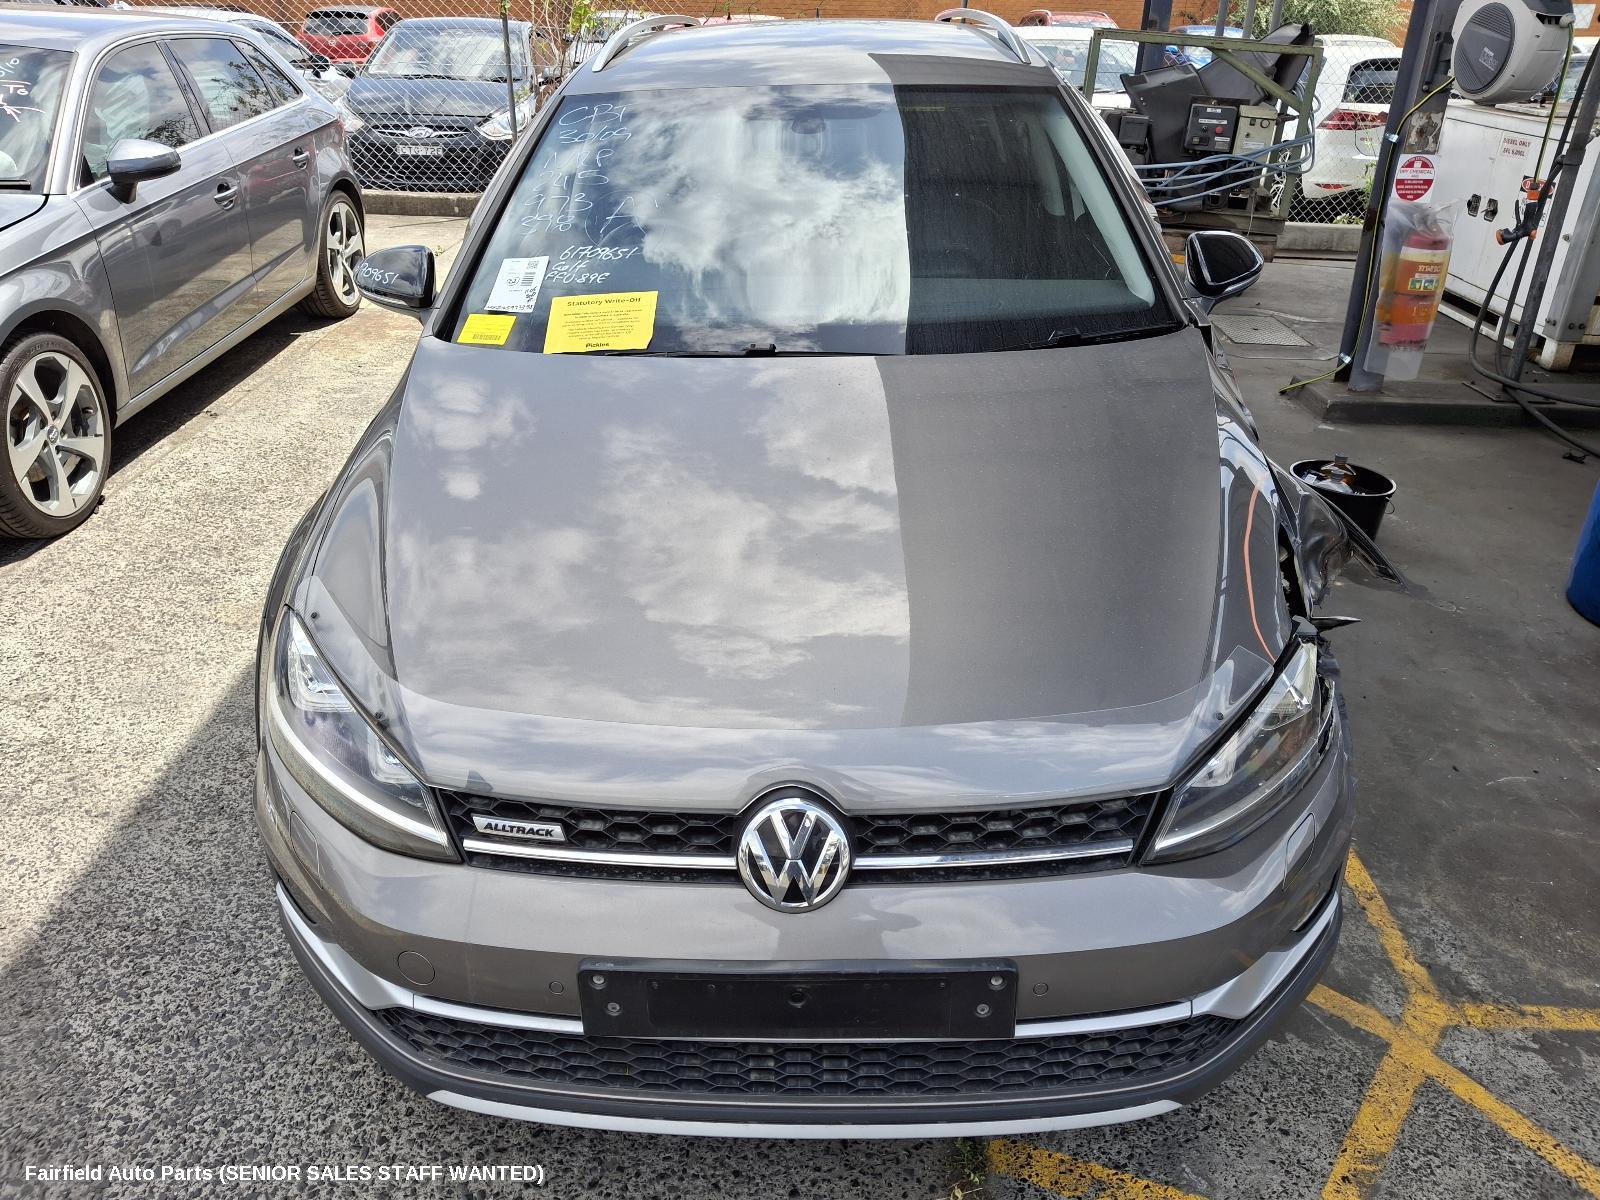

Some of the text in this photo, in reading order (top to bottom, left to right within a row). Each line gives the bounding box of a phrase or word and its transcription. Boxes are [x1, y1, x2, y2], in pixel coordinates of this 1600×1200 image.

[552, 260, 590, 273] Golf
[567, 299, 603, 307] Statutory
[482, 822, 555, 837] ALLTRACK
